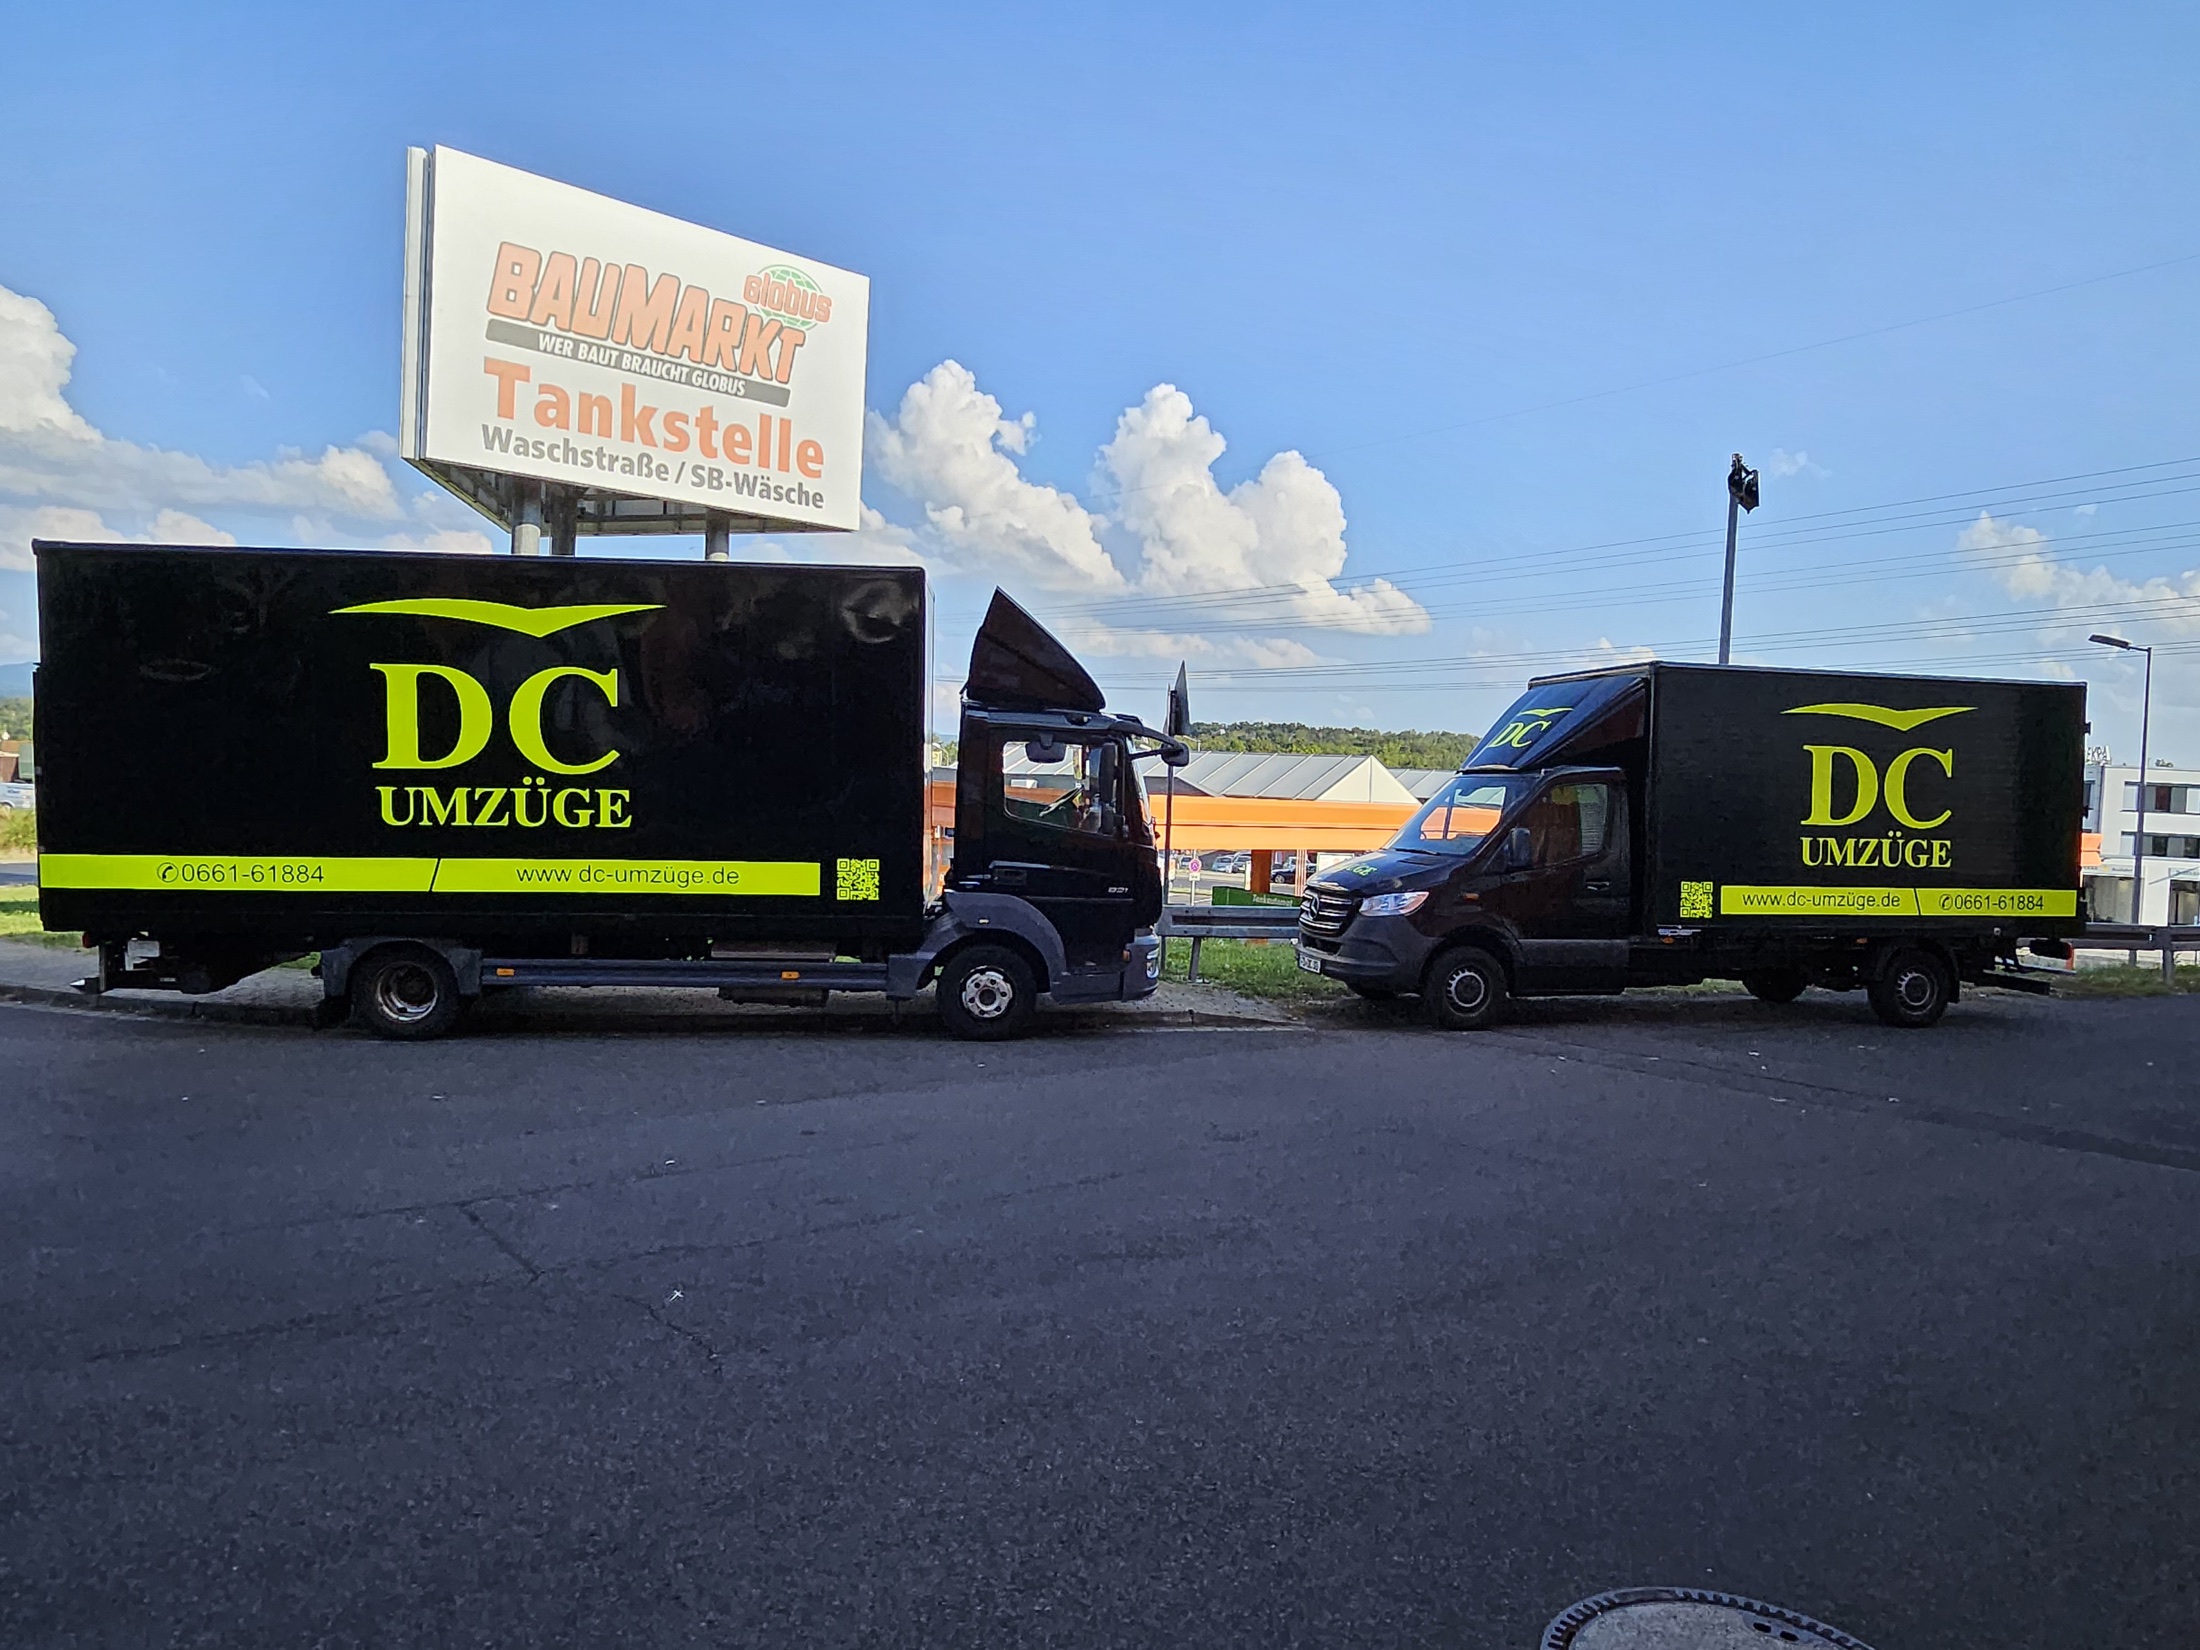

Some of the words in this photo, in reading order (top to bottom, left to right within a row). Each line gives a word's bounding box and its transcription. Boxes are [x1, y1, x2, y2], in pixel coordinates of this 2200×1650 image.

[487, 241, 806, 384] BAUMARKT
[539, 333, 573, 356] WER
[578, 341, 619, 367] BAUT
[621, 349, 690, 384] BRAUCHT
[692, 369, 747, 397] GLOBUS
[484, 356, 825, 480] Tankstelle
[482, 423, 671, 483] Waschstraße
[691, 463, 825, 510] SB-Wäsche
[369, 662, 620, 776] DC
[1488, 720, 1552, 748] DC
[376, 776, 633, 829] UMZÜGE
[1800, 745, 1954, 830] DC
[181, 863, 325, 884] 0661-61884
[1800, 830, 1952, 868] UMZÜGE
[1742, 891, 1901, 911] www.dc-umzüge.de
[1954, 894, 2045, 911] 0661-61884
